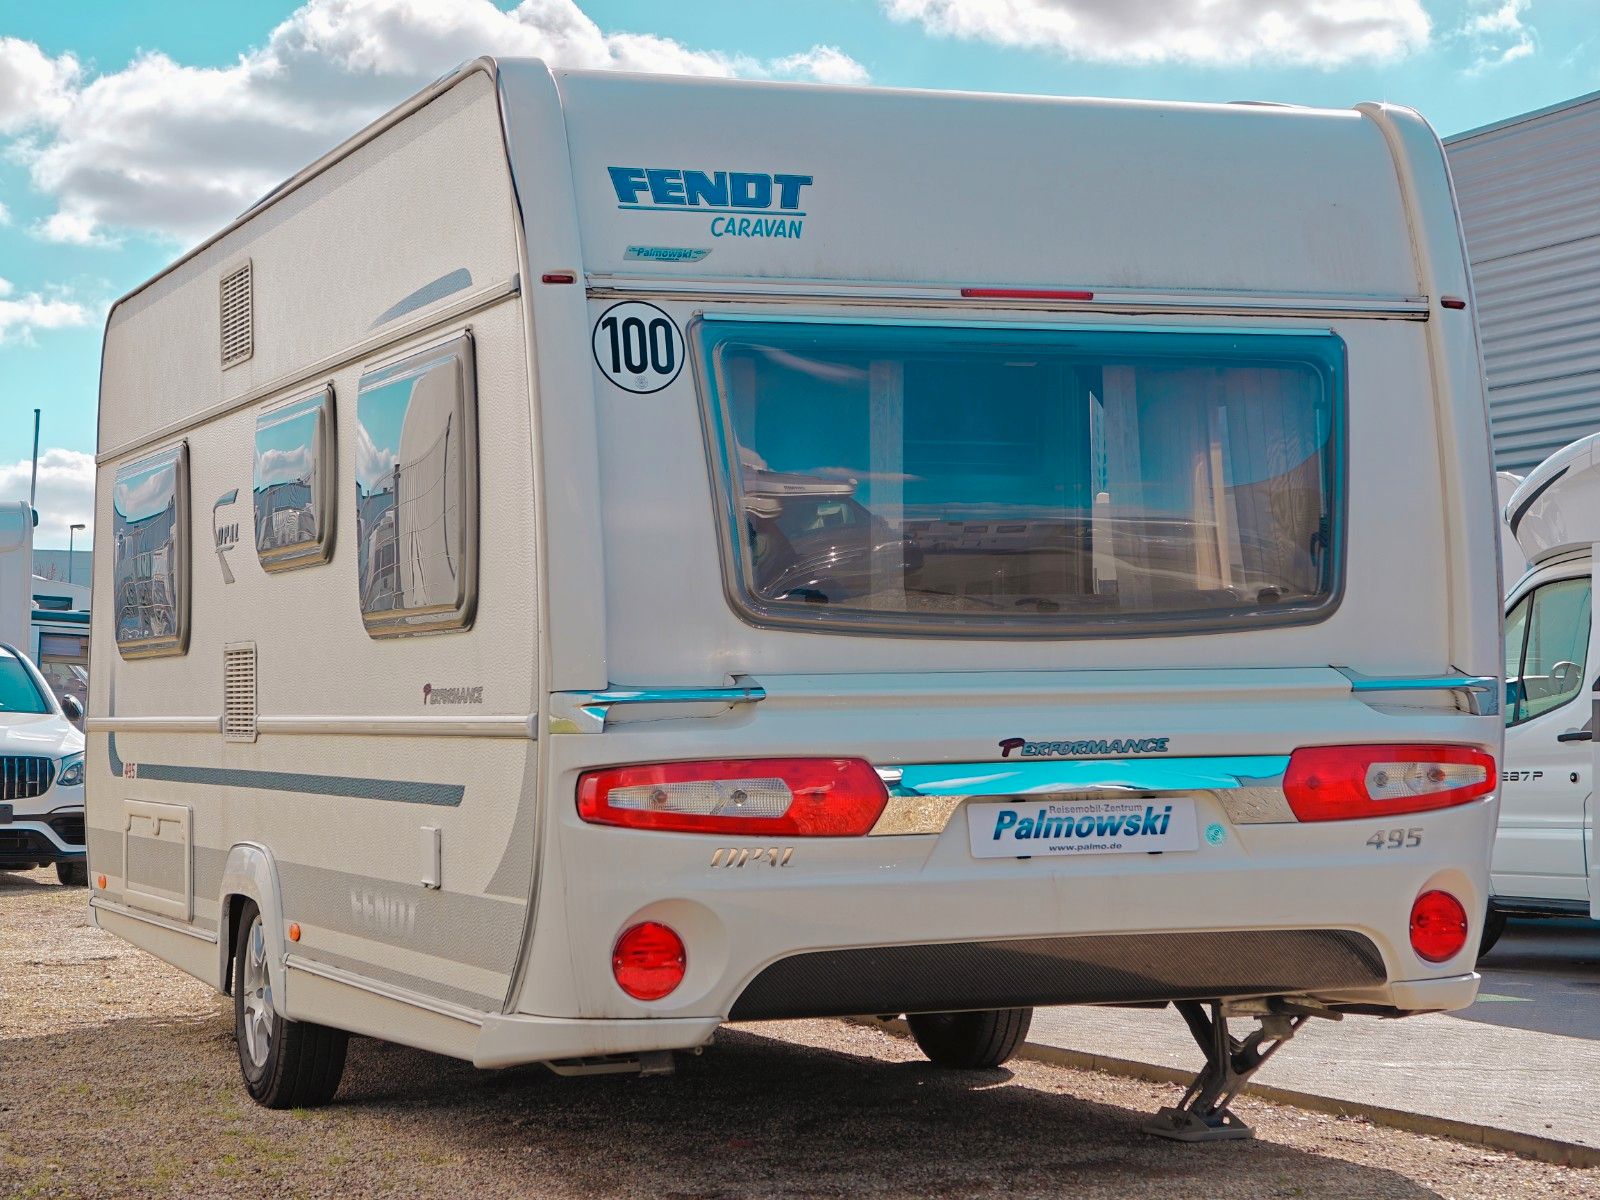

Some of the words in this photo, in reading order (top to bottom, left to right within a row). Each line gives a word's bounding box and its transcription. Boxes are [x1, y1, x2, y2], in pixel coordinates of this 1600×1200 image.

[607, 166, 813, 209] FENDT
[711, 217, 803, 239] CARAVAN
[636, 247, 693, 259] Palmowski
[602, 316, 675, 375] 100
[999, 737, 1170, 758] PERFORMANCE
[124, 762, 135, 779] 495
[1049, 804, 1143, 814] Reisemobil-Zentrum
[993, 806, 1173, 840] Palmowski
[1049, 842, 1123, 852] www.palmo.de
[1366, 828, 1424, 849] 495
[710, 846, 797, 868] OPAL
